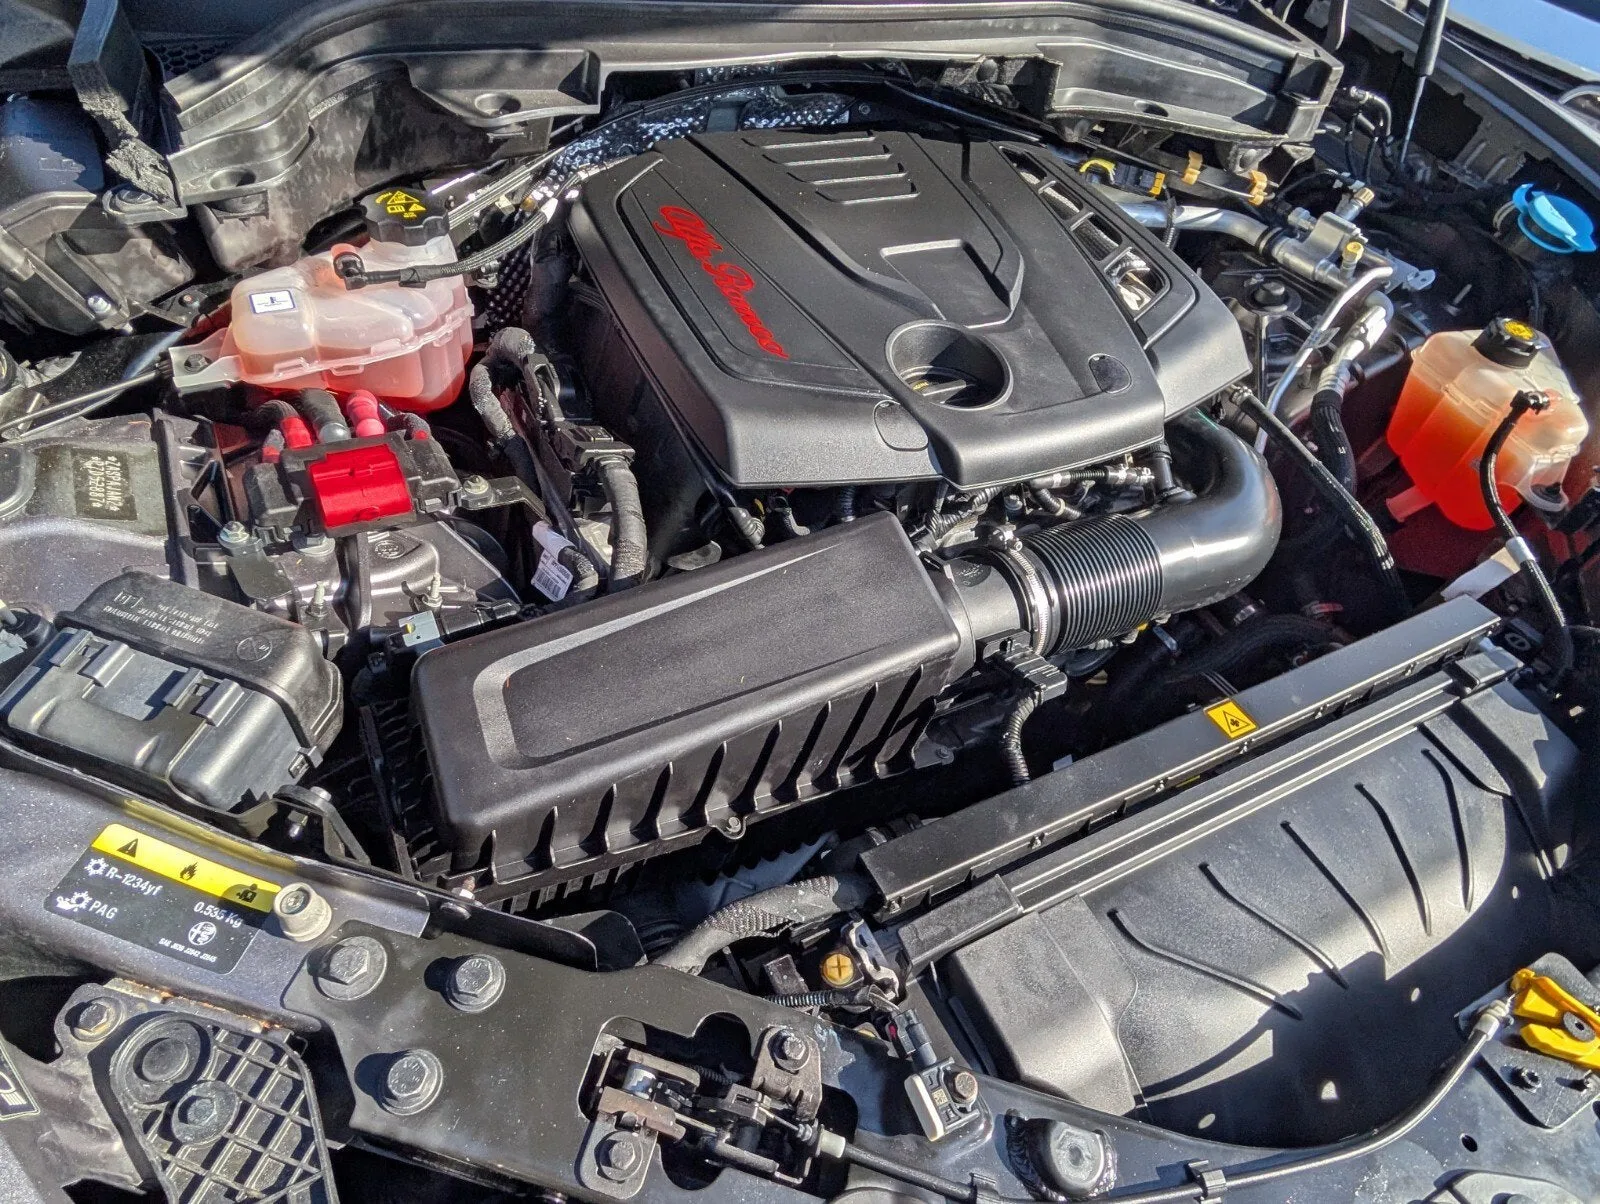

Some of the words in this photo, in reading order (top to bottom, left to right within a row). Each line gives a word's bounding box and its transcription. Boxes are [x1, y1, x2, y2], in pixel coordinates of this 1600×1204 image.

[652, 206, 723, 264] Alfa
[702, 261, 790, 359] Romeo
[105, 866, 163, 896] R-1234yf
[89, 900, 118, 919] PAG
[193, 901, 225, 921] 0.535
[224, 912, 243, 928] Kg
